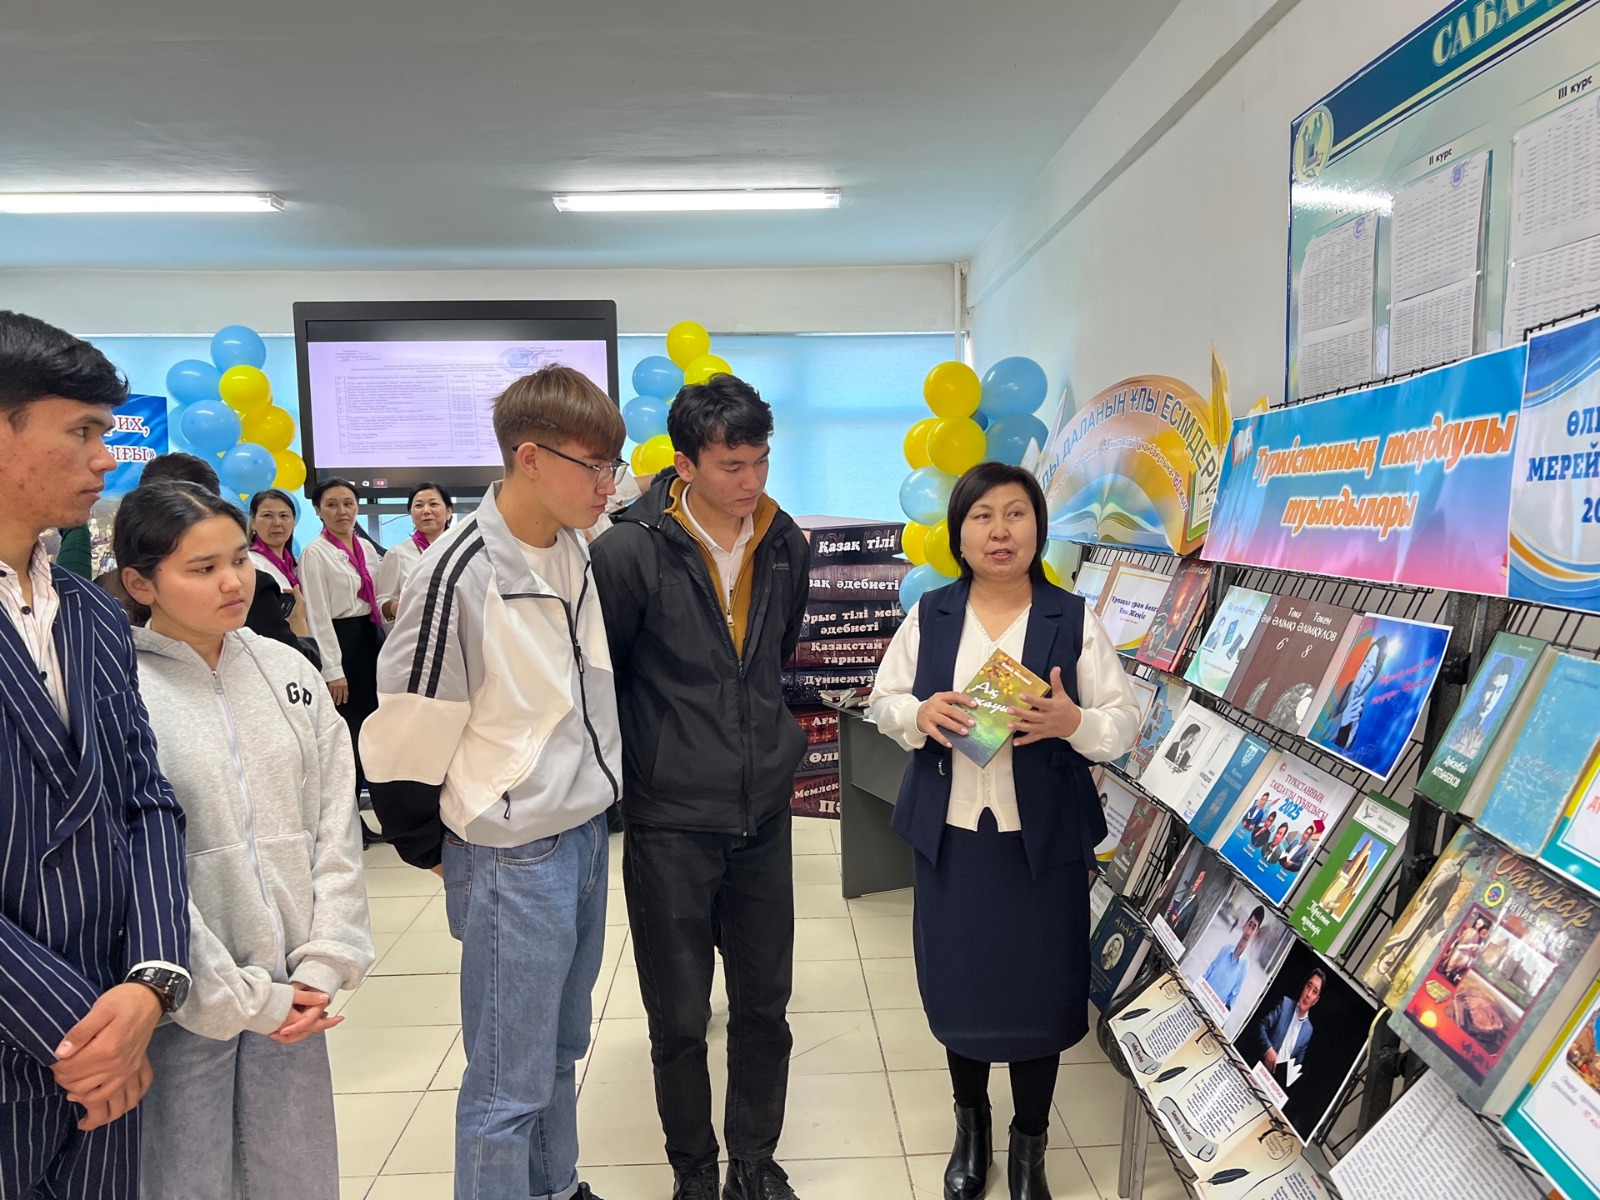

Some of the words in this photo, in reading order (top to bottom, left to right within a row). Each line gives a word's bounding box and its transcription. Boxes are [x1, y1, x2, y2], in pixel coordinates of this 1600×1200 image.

[1570, 75, 1593, 94] курс
[1435, 148, 1453, 164] курс
[1062, 391, 1127, 463] ДАЛАНЫҢ
[1129, 387, 1161, 414] ҰЛЫ
[1160, 393, 1219, 495] ЕСІМДЕРІ
[1255, 437, 1379, 485] Түркістанның
[1381, 415, 1517, 470] таңдаулы
[1282, 487, 1419, 538] туындылары
[818, 541, 860, 554] Қазақ
[867, 535, 895, 549] тілі
[836, 578, 899, 590] әдебиеті
[803, 612, 836, 624] Орыс
[842, 608, 868, 620] тілі
[875, 608, 901, 618] мен
[1313, 612, 1333, 625] Тәкен
[820, 622, 879, 635] әдебиеті
[811, 641, 883, 652] Қазақстан
[1276, 637, 1289, 651] 6
[1301, 644, 1313, 658] 8
[823, 655, 875, 665] тарихы
[971, 681, 999, 699] Ақ
[1278, 796, 1303, 820] 2025
[1495, 853, 1594, 930] Отырар
